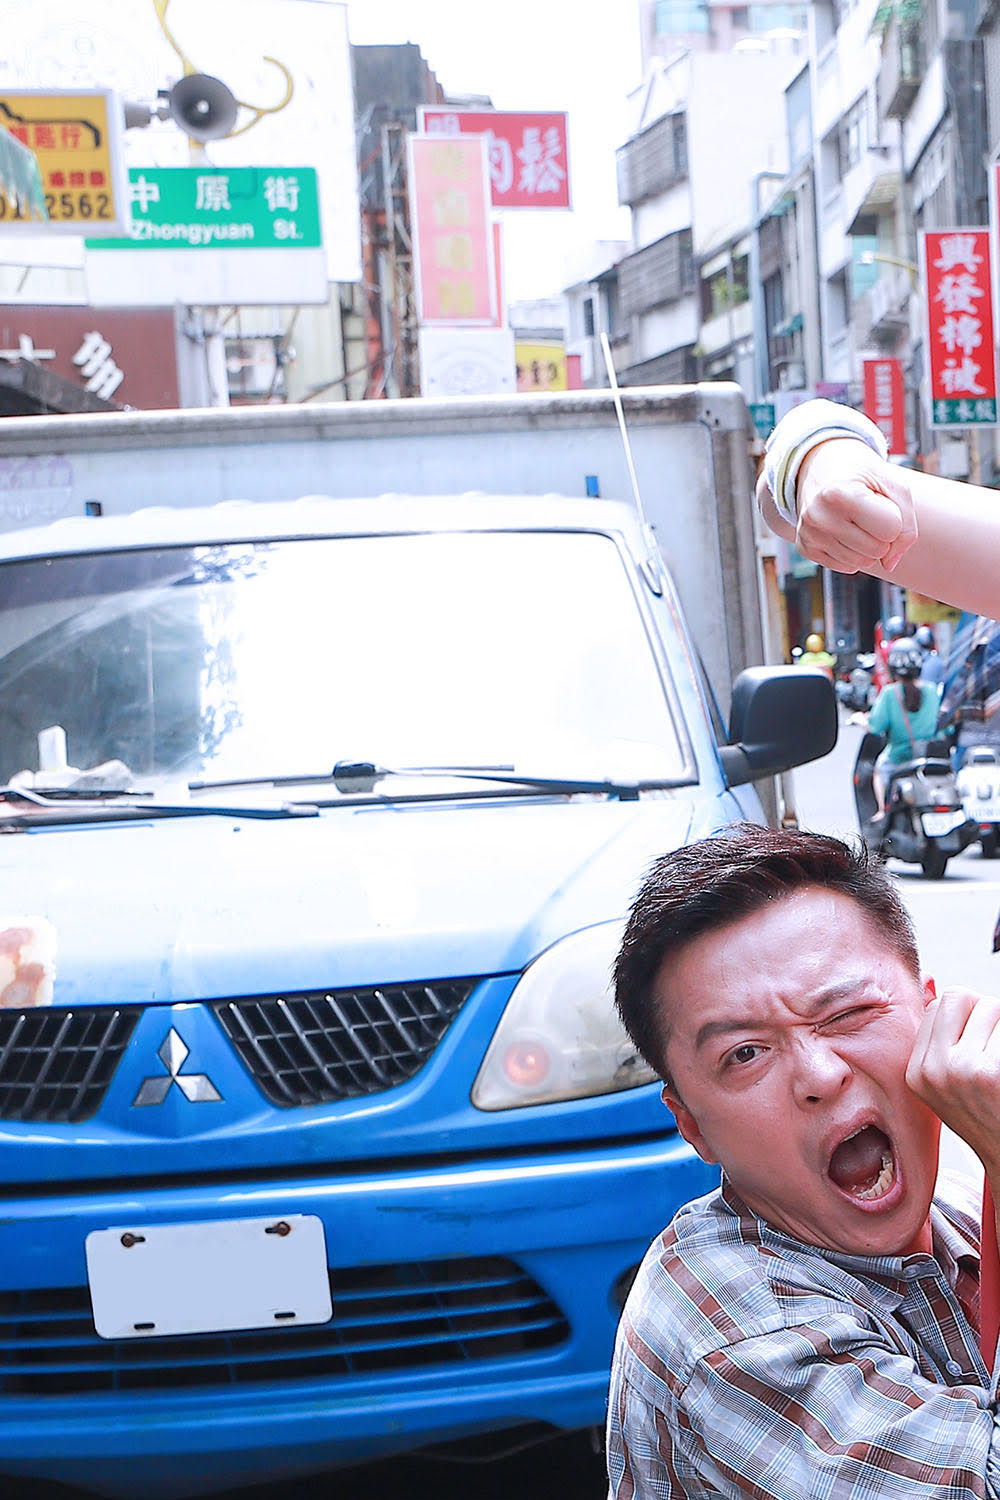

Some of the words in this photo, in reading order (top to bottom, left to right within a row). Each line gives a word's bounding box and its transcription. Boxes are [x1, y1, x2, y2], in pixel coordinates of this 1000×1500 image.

[129, 175, 300, 212] 中原街
[132, 219, 254, 245] Zhongyuan
[934, 234, 986, 394] 興發棉被
